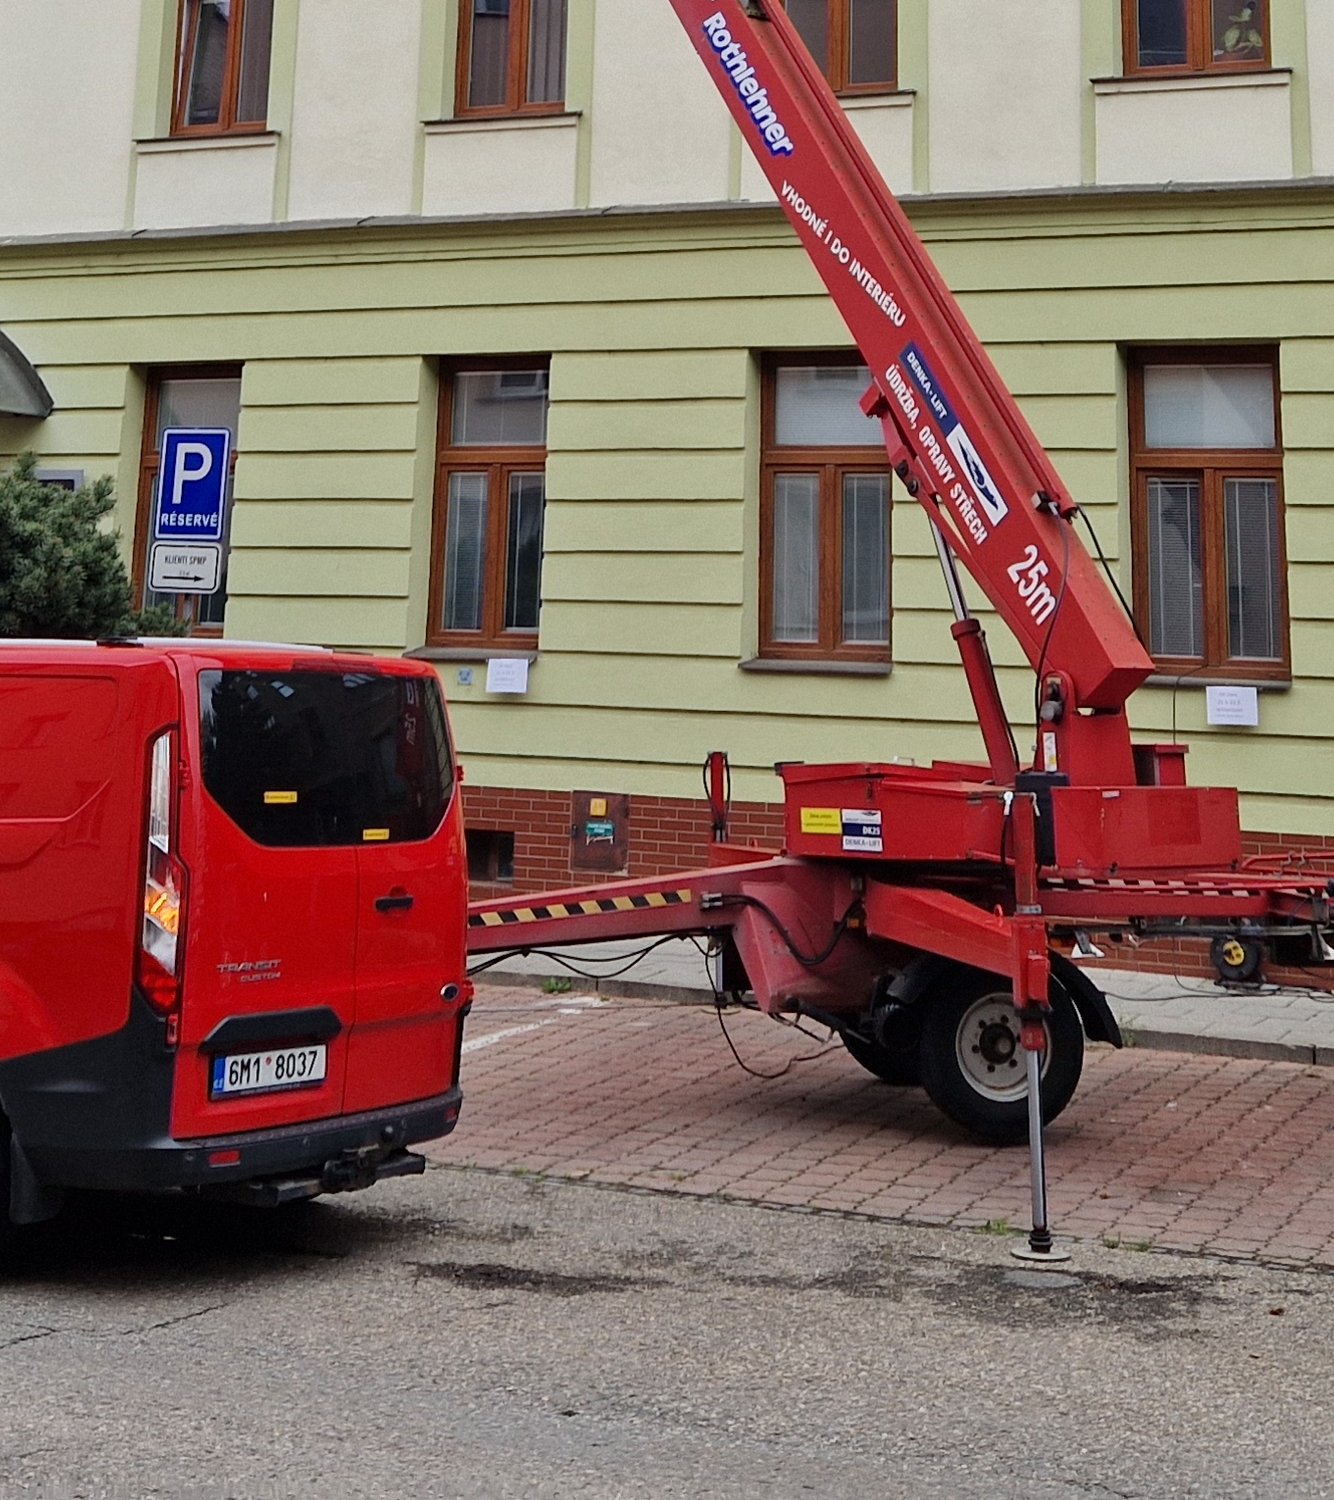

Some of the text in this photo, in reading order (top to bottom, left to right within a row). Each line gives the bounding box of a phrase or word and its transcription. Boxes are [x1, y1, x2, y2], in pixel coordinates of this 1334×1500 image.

[703, 11, 794, 156] Rothlehner
[781, 179, 906, 328] VHODNÉ I DO INTERIÉRU
[172, 442, 213, 505] P
[885, 364, 988, 545] ÚDRŽBA, OPRAVY STŘECH
[161, 511, 219, 528] RÉSERVÉ
[1006, 544, 1056, 626] 25m
[217, 959, 282, 973] TRANSIT
[240, 972, 281, 983] CUSTOM
[228, 1050, 318, 1086] 6M1 8037
